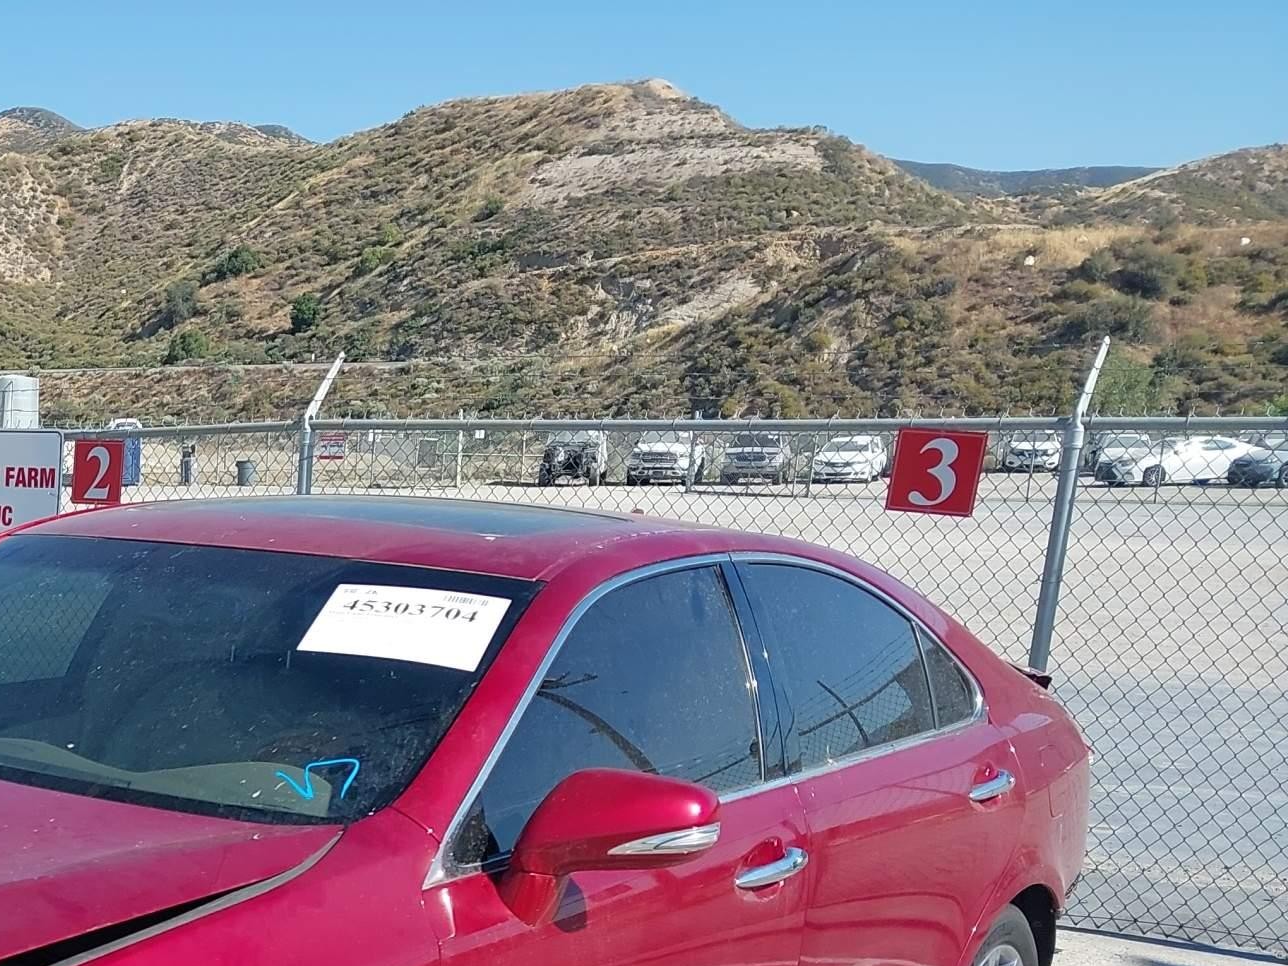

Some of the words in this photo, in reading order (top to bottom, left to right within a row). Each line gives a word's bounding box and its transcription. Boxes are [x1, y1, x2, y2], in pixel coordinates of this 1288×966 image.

[4, 465, 57, 489] FARM
[83, 446, 111, 500] 2
[907, 437, 960, 506] 3
[343, 599, 479, 623] 45303704
